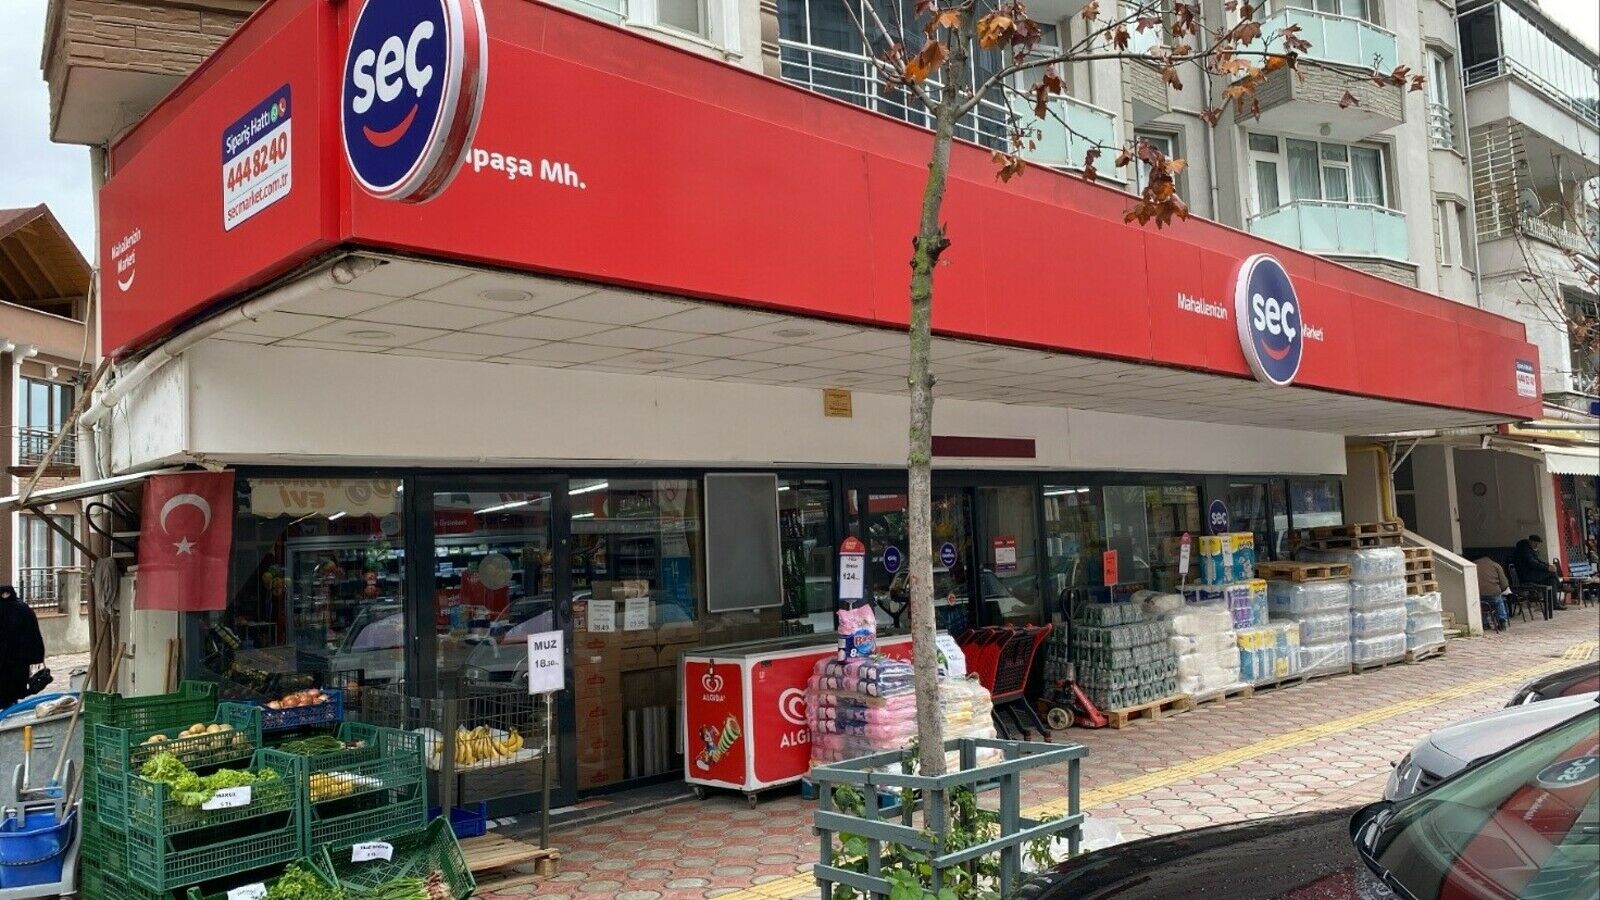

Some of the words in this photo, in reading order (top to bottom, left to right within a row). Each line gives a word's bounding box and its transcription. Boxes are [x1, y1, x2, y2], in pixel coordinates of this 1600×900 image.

[352, 20, 435, 114] seç
[226, 125, 250, 155] Sipariş
[250, 110, 270, 138] Hattı
[540, 159, 587, 189] Mh.
[1177, 291, 1228, 320] Mahallenizin
[1252, 293, 1297, 343] seç
[534, 640, 558, 651] MUZ
